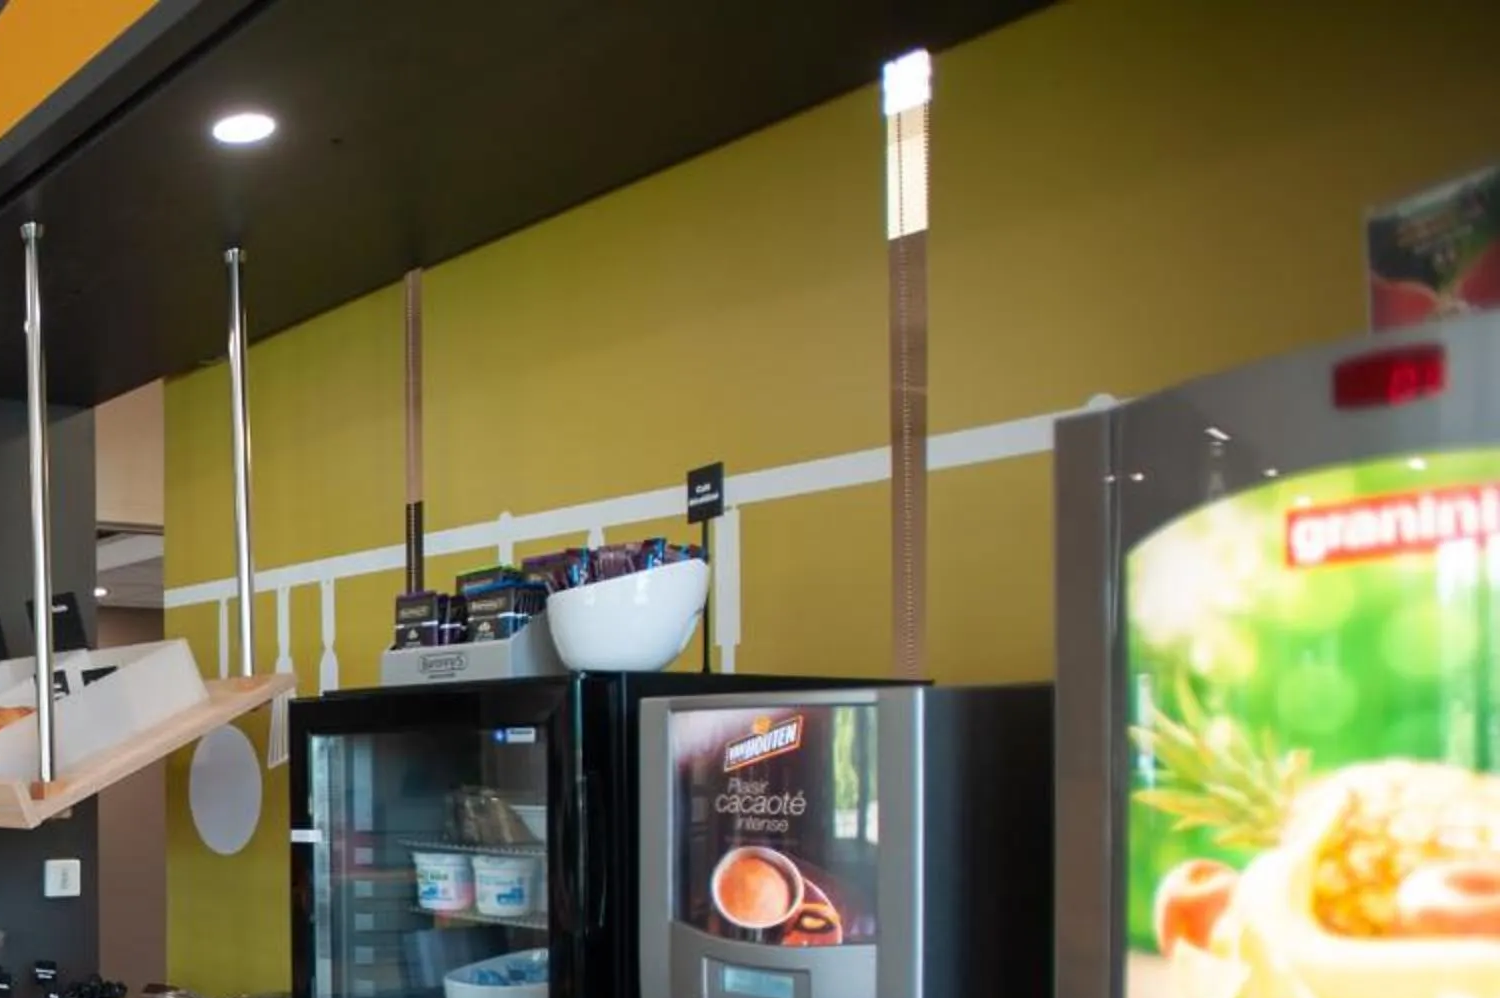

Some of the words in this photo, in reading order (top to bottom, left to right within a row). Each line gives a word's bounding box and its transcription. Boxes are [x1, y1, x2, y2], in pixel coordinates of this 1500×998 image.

[1291, 487, 1499, 563] granini
[745, 722, 797, 760] HOUTEN
[715, 789, 807, 816] cacaoté
[735, 816, 789, 833] intense
